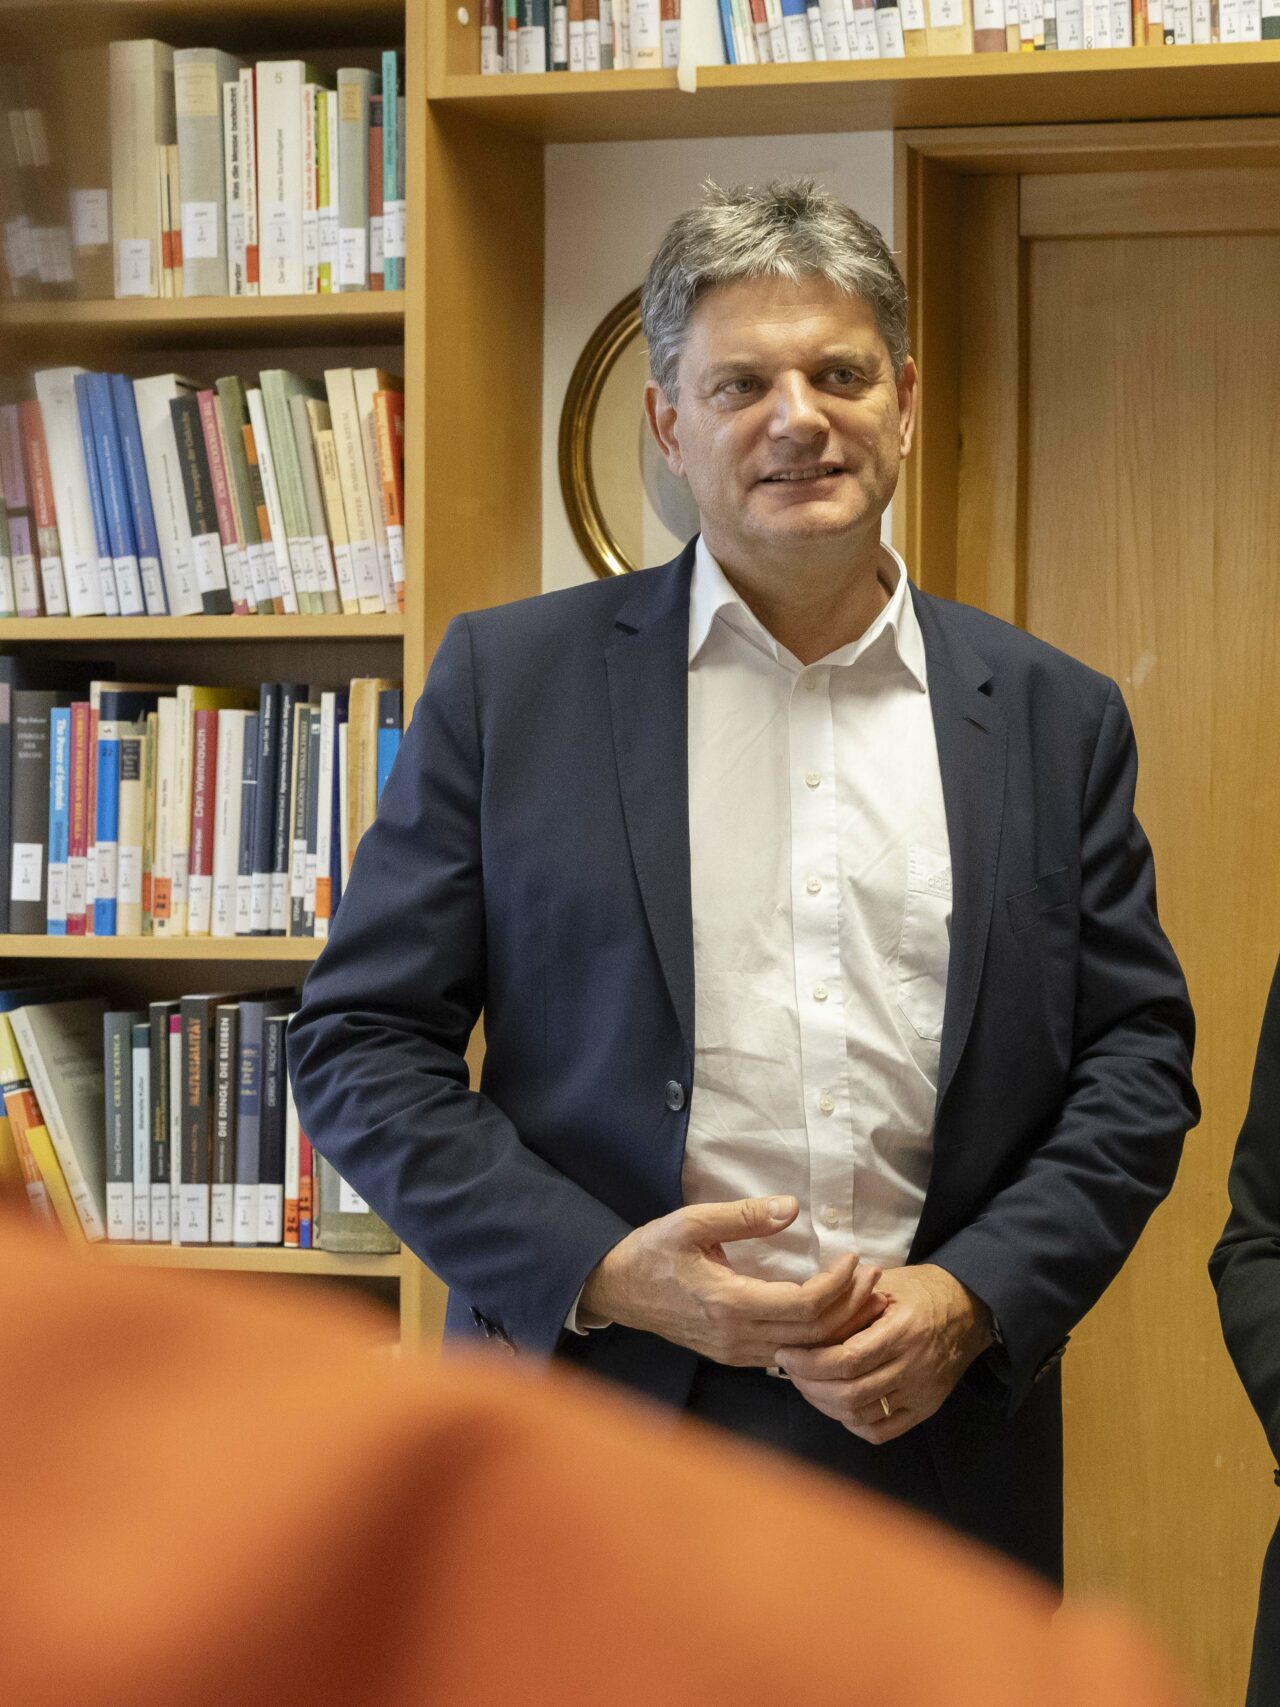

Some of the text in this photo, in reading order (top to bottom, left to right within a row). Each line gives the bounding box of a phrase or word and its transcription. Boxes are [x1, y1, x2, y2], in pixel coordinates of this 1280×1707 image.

[230, 87, 240, 199] Was die Messe bedeutet
[234, 263, 242, 295] Herder
[76, 708, 84, 748] CURRENT
[195, 728, 206, 791] Weihrauch
[55, 719, 66, 811] The Power of Symbols
[194, 794, 204, 817] Der
[113, 1079, 121, 1107] CRUX
[187, 1017, 201, 1107] MATERIALITÄT
[218, 1017, 230, 1137] DIE DINGE, DIE BLEIBEN
[267, 1024, 277, 1107] DERRIDA FALSCHGELD
[114, 1153, 122, 1176] Heiko
